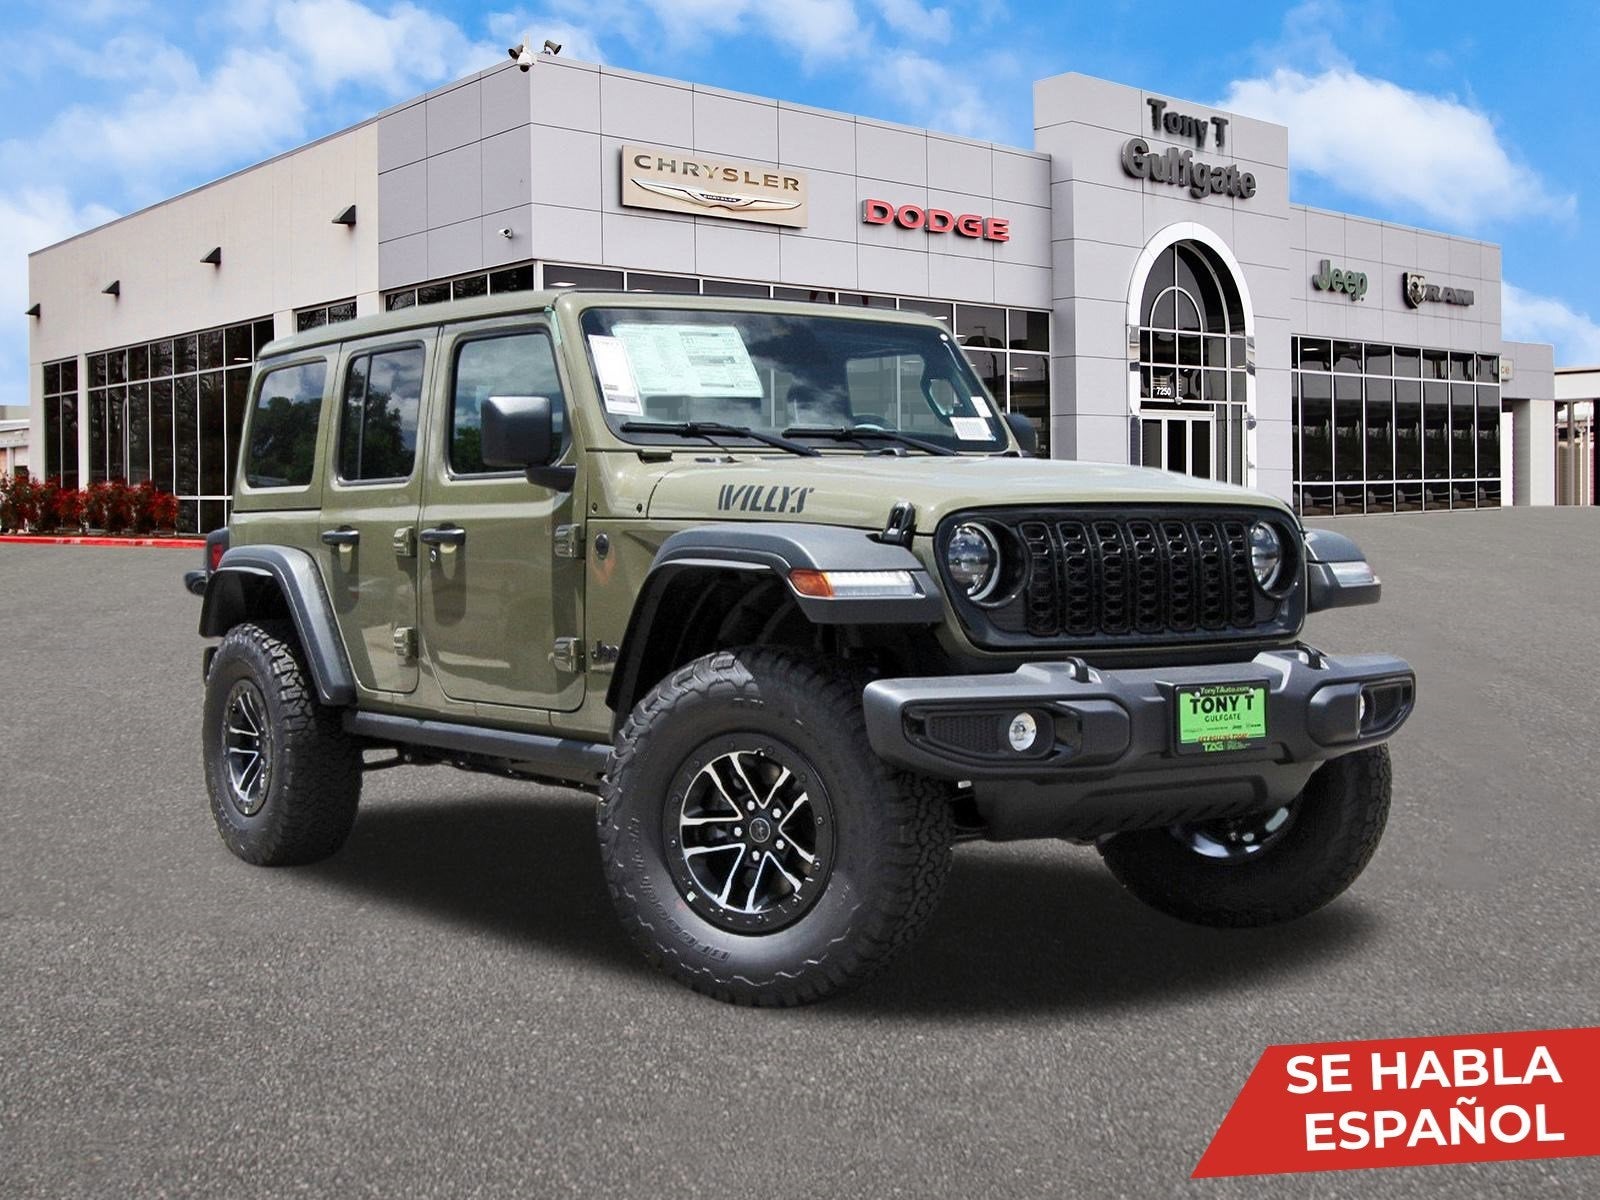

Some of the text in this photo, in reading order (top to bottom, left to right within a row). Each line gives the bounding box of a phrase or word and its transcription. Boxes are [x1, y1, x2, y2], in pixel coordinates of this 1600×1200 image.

[1147, 98, 1229, 148] Tony T
[634, 154, 800, 192] CHRYSLER
[1122, 138, 1257, 199] Gulfgate
[863, 199, 1010, 242] DODGE
[1313, 259, 1368, 302] Jeep
[1425, 284, 1475, 307] RAM
[1156, 386, 1172, 396] 7250
[718, 484, 815, 513] WILLYS
[1189, 694, 1254, 715] TONY T
